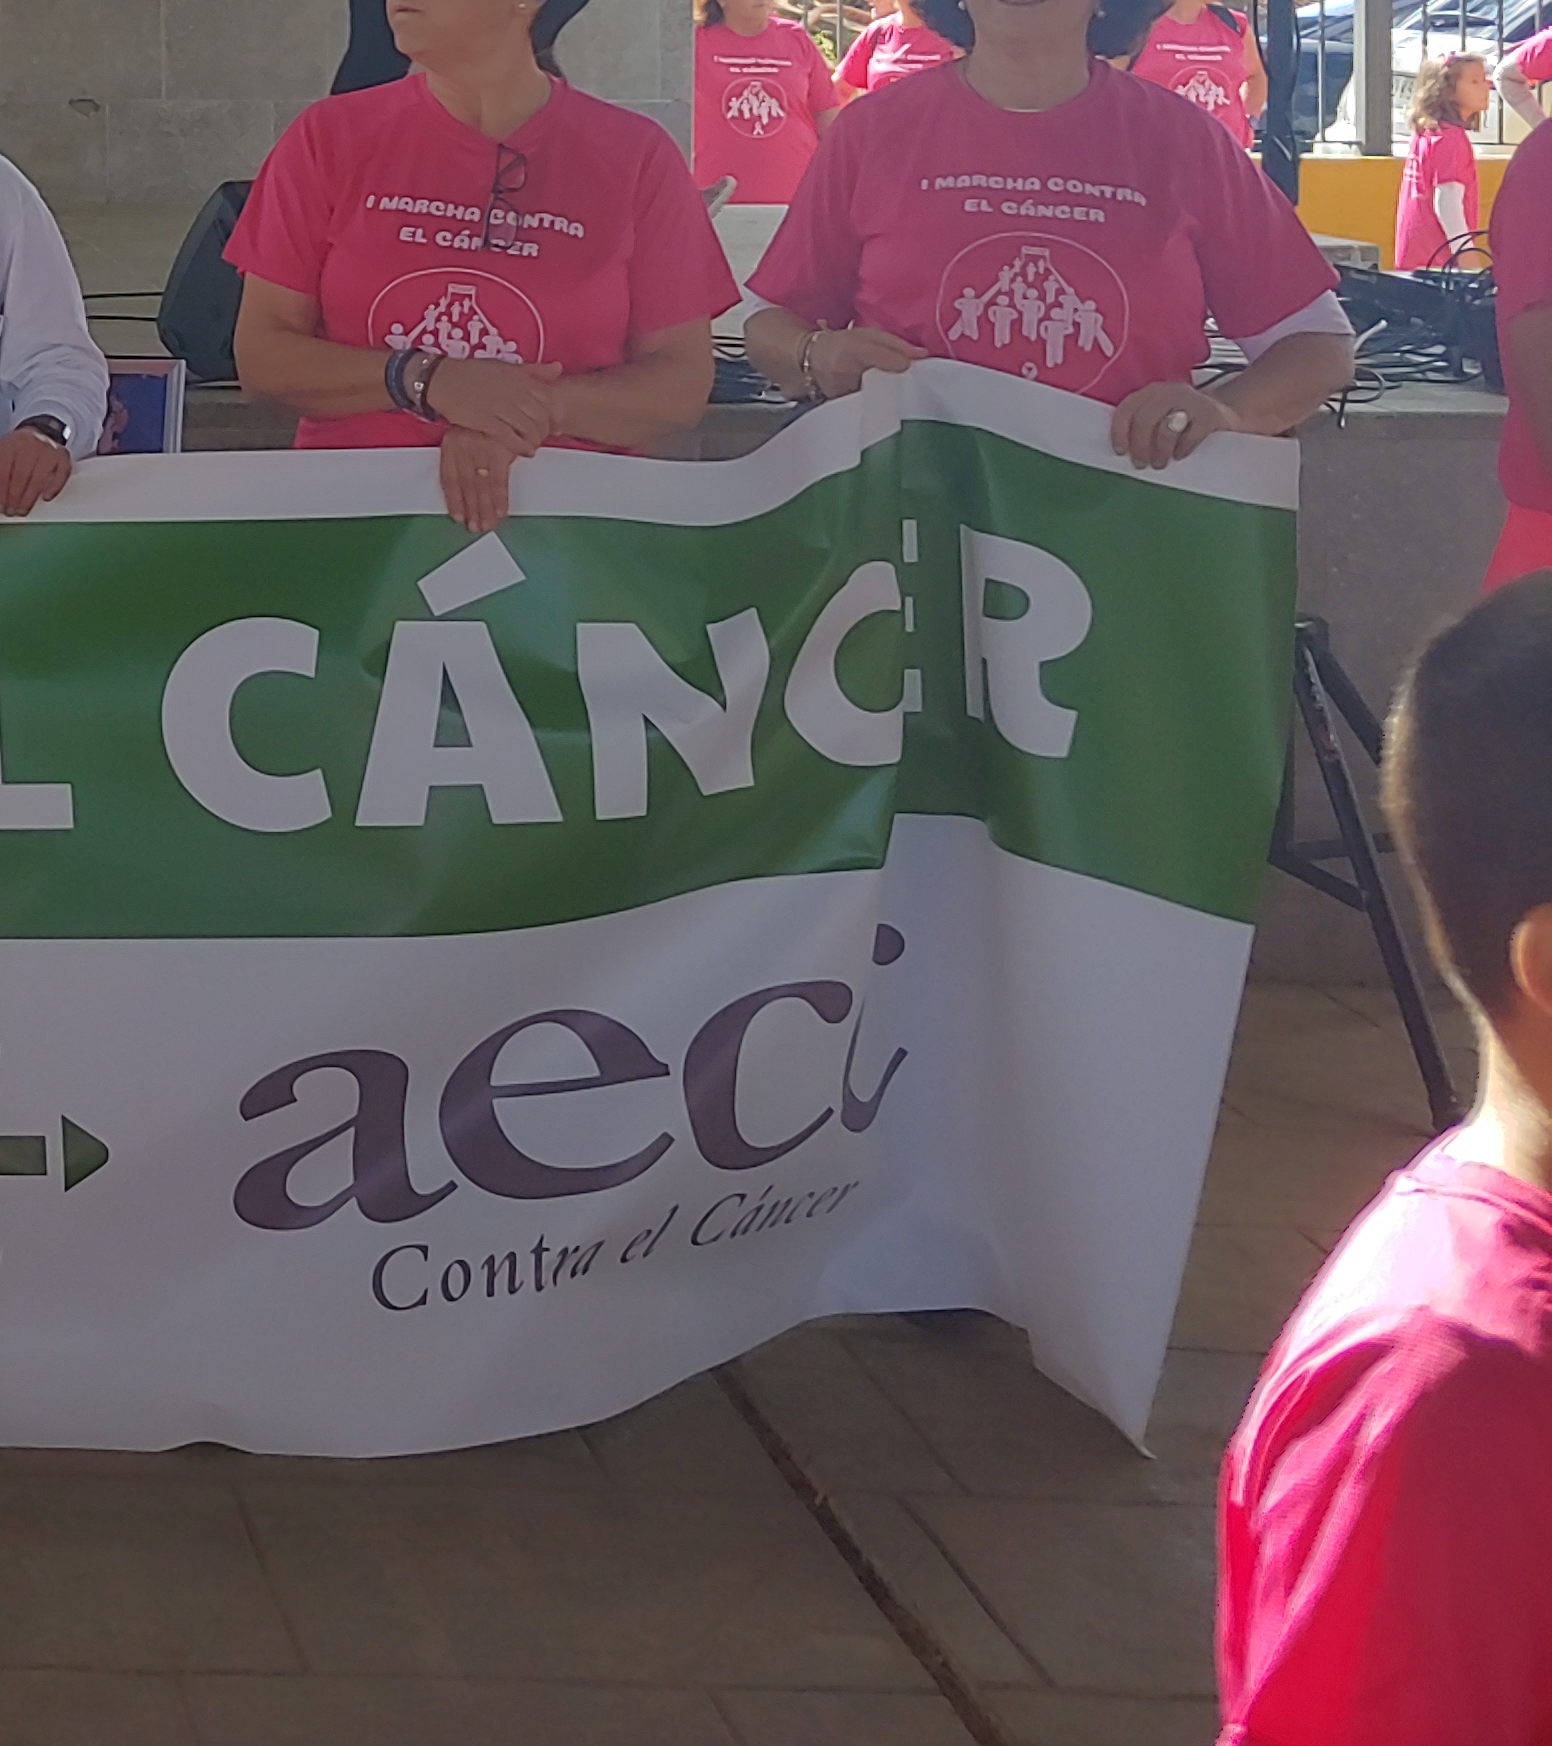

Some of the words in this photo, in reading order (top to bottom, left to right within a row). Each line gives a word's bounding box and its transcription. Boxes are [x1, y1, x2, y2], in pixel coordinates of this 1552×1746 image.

[934, 174, 1041, 191] MARCHA
[1046, 175, 1147, 206] CONTRA
[379, 195, 481, 222] MARCHA
[489, 209, 585, 238] CONTRA
[964, 198, 994, 213] EL
[1000, 199, 1106, 223] CÁNCER
[399, 226, 428, 243] EL
[161, 521, 1093, 833] CÁNCR
[371, 1234, 605, 1311] Contra
[618, 1204, 680, 1264] el
[690, 1179, 861, 1248] Cáncer
